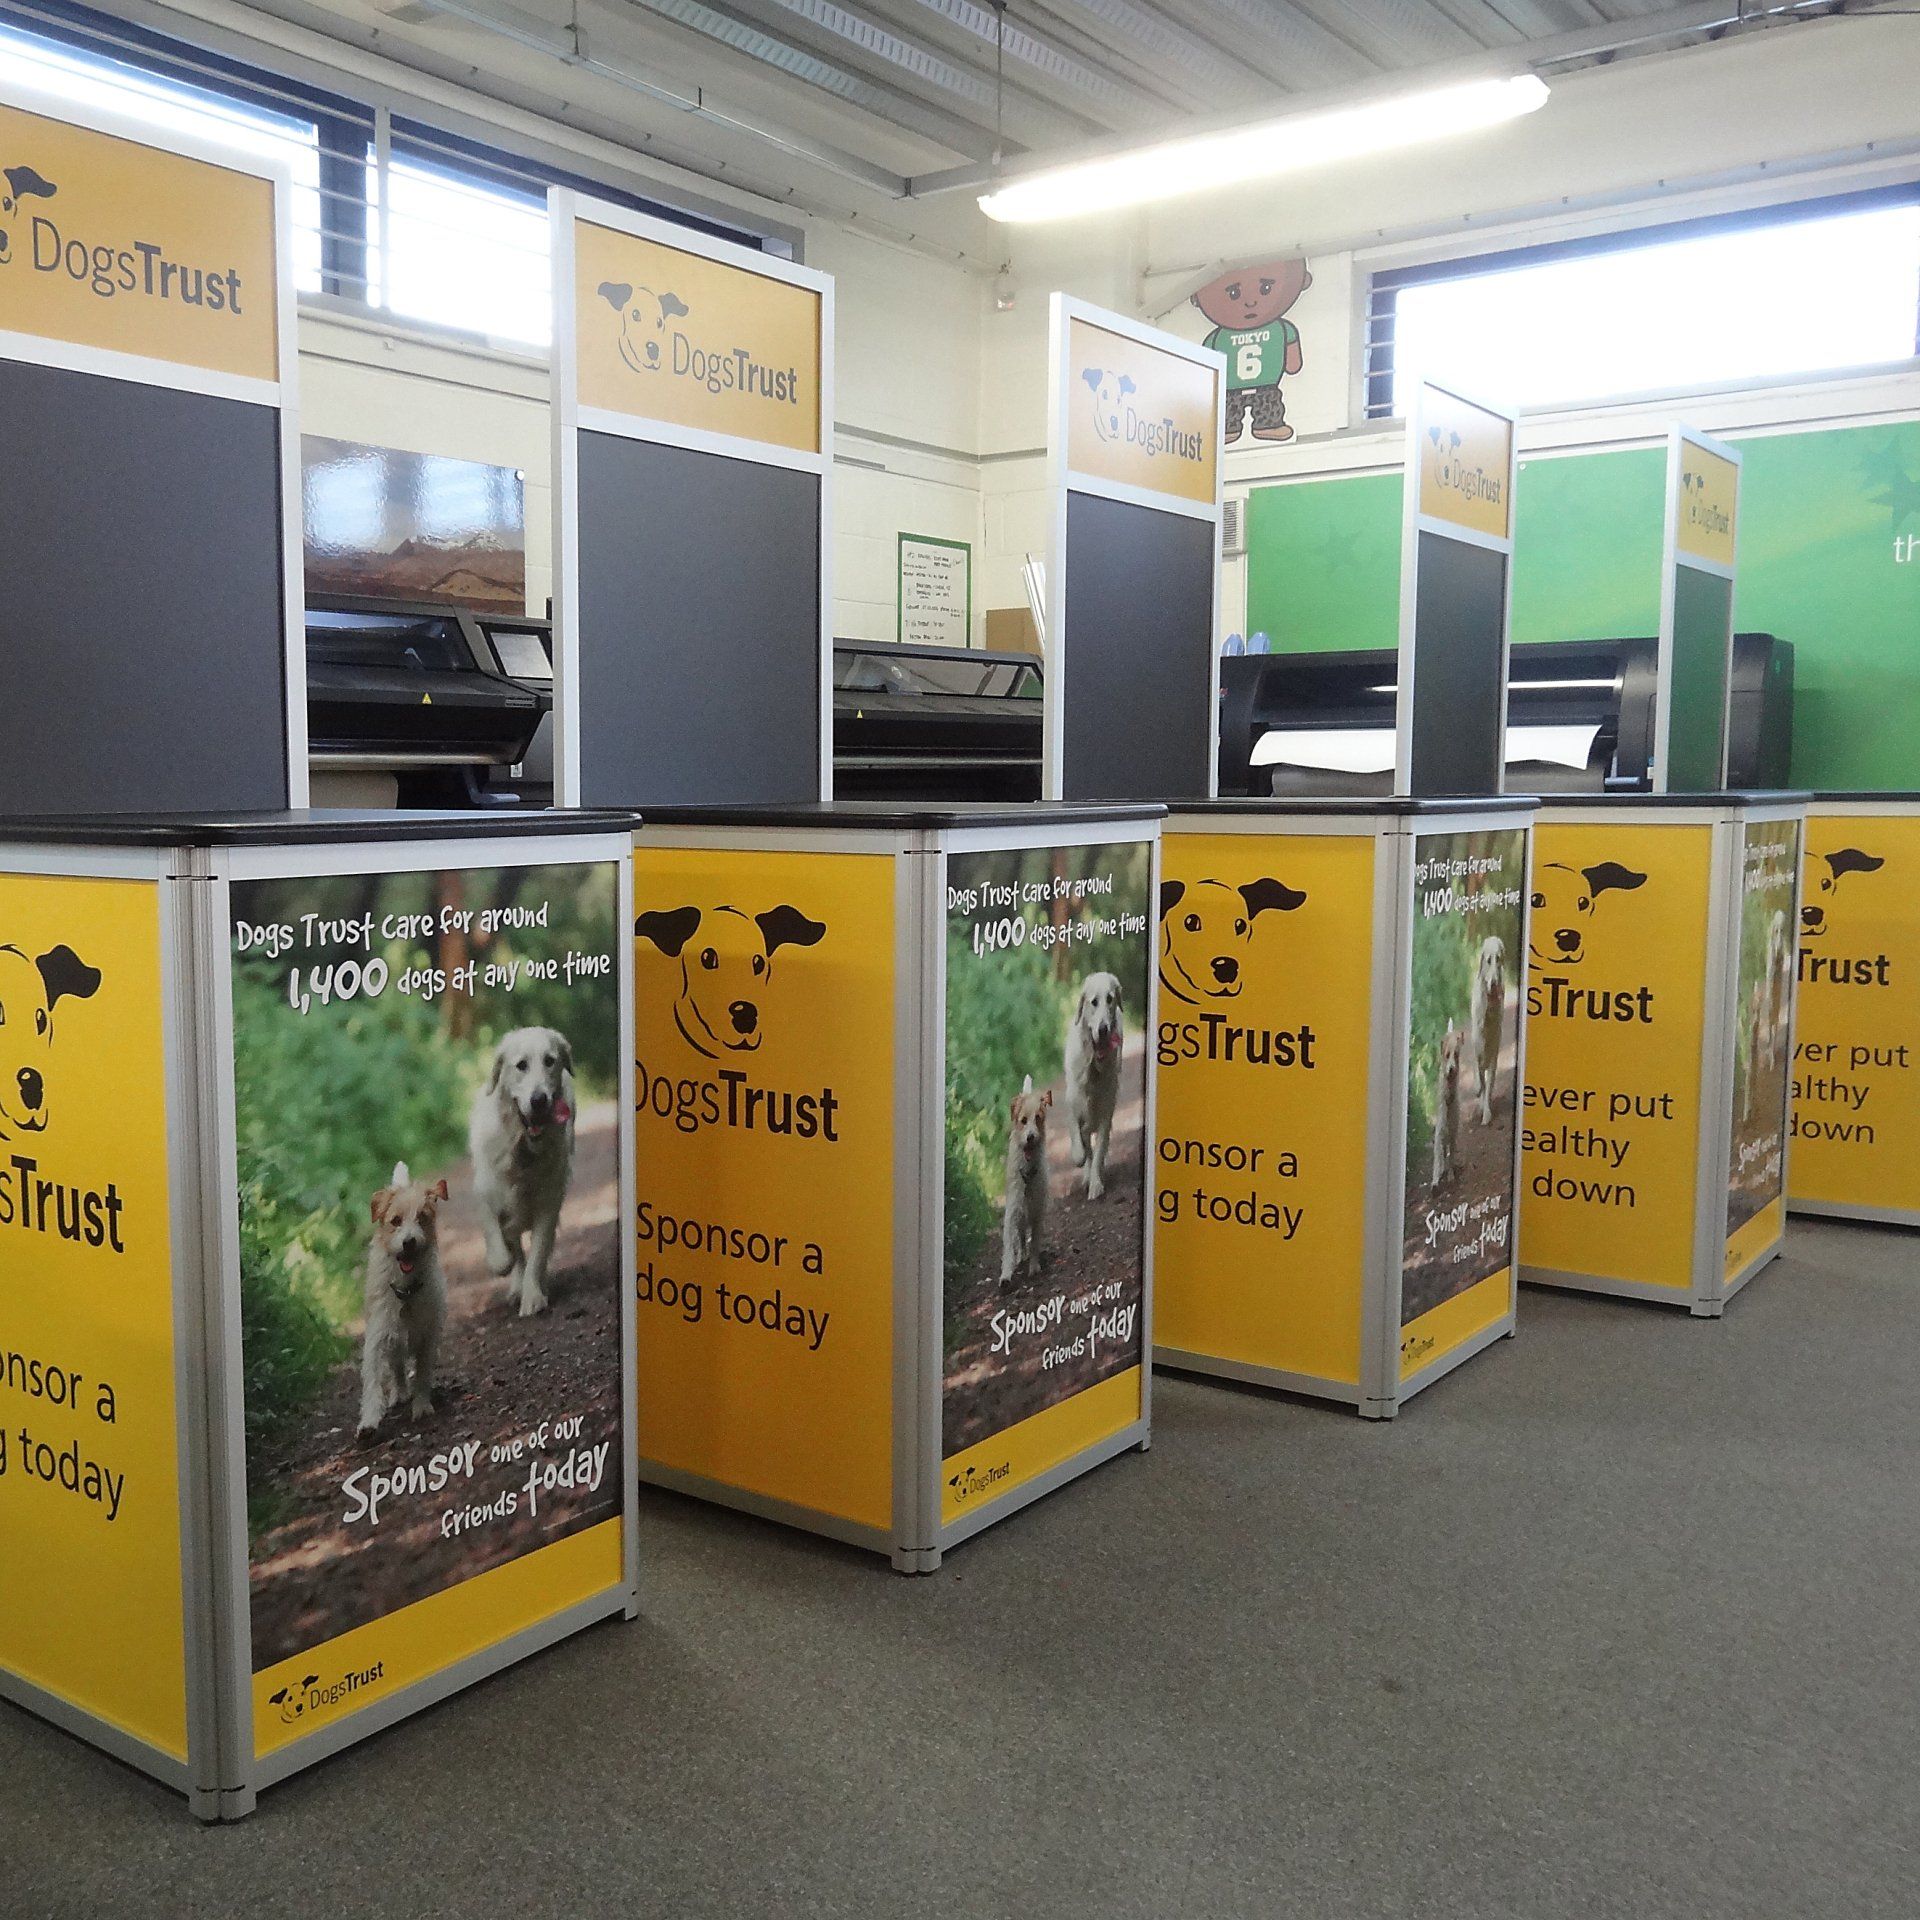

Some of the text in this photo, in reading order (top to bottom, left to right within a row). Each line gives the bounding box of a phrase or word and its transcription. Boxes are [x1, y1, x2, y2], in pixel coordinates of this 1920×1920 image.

[32, 216, 242, 315] DogsTrust
[1230, 330, 1270, 346] TOKYO
[1237, 344, 1262, 380] 6
[672, 331, 797, 404] DogsTrust
[1126, 407, 1203, 462] DogsTrust
[948, 873, 1113, 916] Dogs Trust care for around
[236, 901, 549, 958] Dogs Trust care for around
[973, 916, 1026, 959] 1,400
[1030, 922, 1056, 950] dogs
[1058, 918, 1074, 948] at
[1076, 919, 1096, 945] any
[1119, 912, 1147, 941] time
[289, 950, 611, 1015] 1,400 dogs at any one time
[1850, 1045, 1910, 1071] put
[1609, 1092, 1674, 1122] put
[1159, 1137, 1298, 1178] onsor a
[1192, 1188, 1304, 1241] today
[1532, 1168, 1636, 1208] down
[636, 1202, 822, 1275] Sponsor a
[636, 1263, 830, 1351] dog today
[990, 1295, 1066, 1356] Sponsor
[1070, 1300, 1089, 1314] one
[1105, 1281, 1123, 1300] our
[1042, 1336, 1085, 1370] friends
[1086, 1303, 1137, 1359] today
[96, 1383, 116, 1424] a
[18, 1427, 125, 1522] today
[341, 1415, 584, 1525] Sponsor one of our
[440, 1490, 518, 1539] friends
[522, 1441, 610, 1517] today
[309, 1661, 384, 1710] DogsTrust
